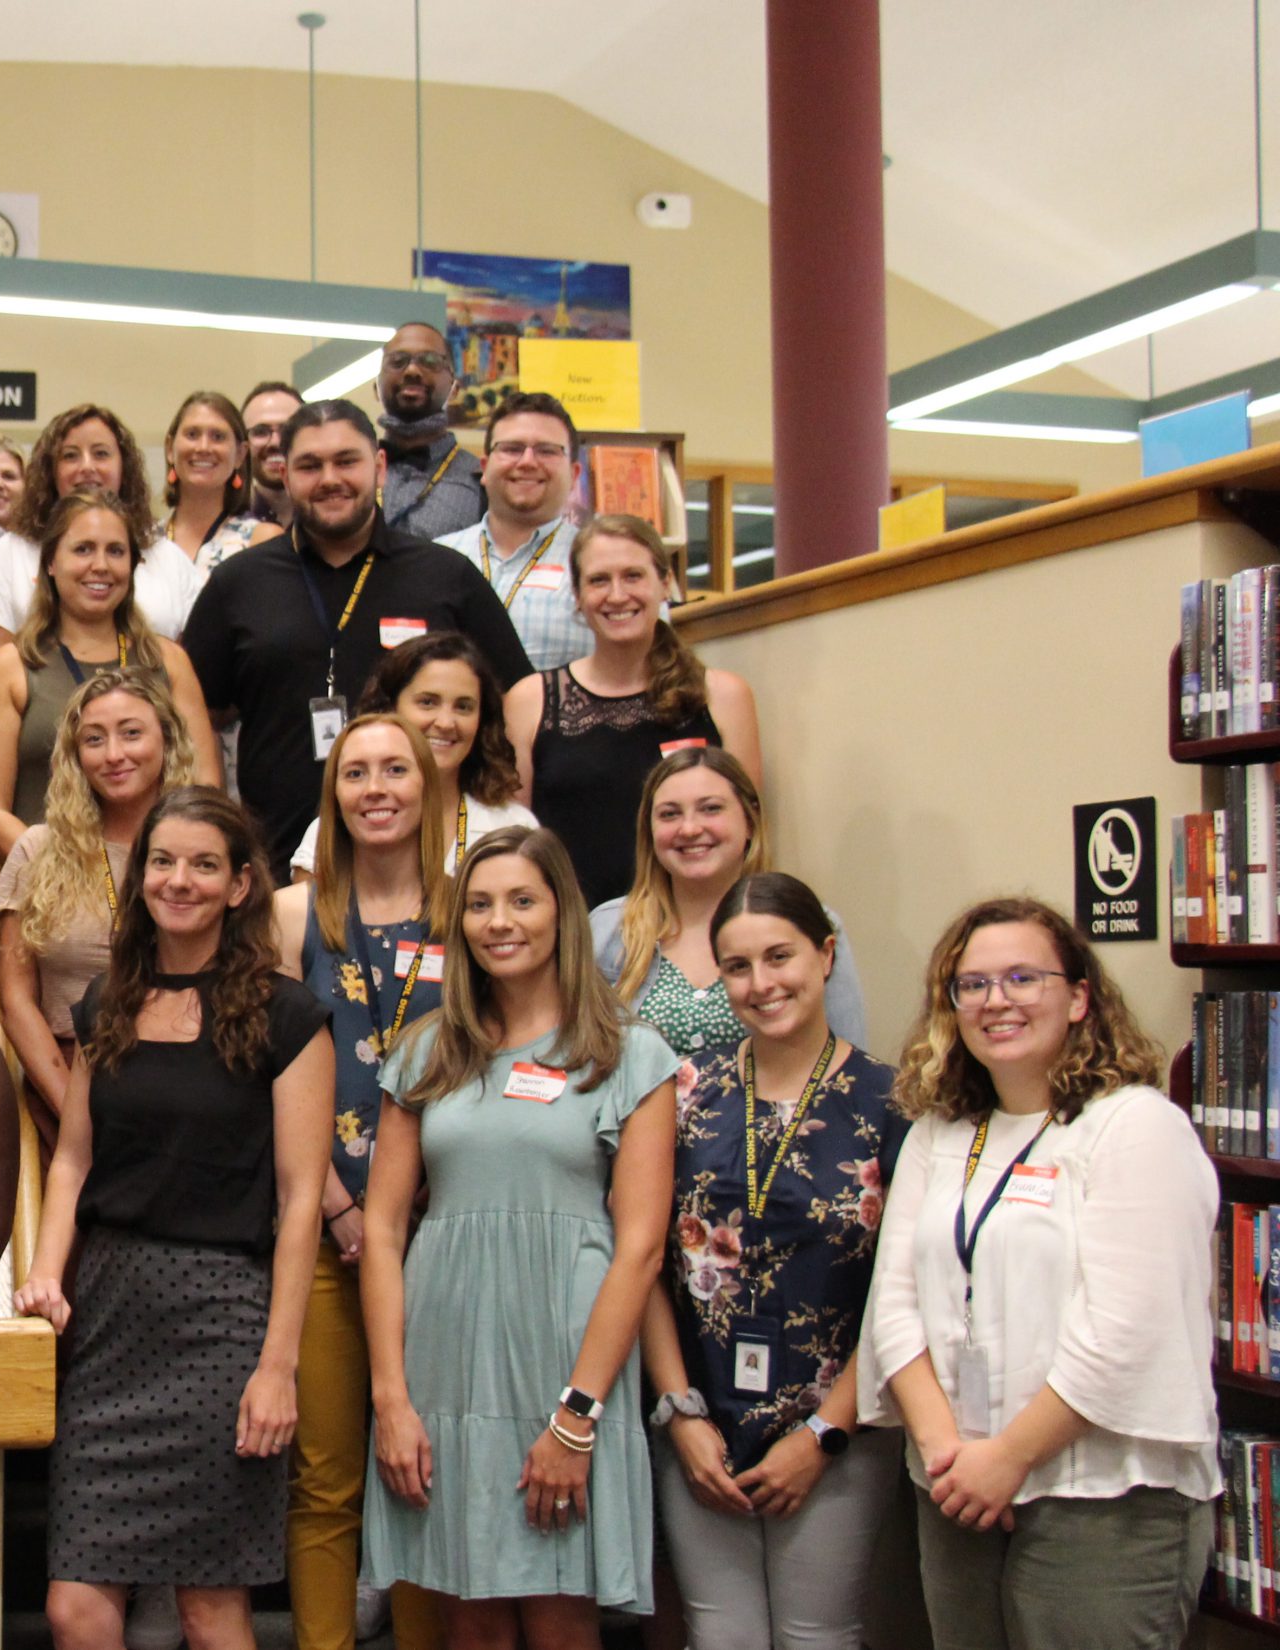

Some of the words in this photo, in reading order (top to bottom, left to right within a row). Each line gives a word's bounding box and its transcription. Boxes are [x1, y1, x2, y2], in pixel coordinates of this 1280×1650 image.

[568, 373, 592, 384] New
[1092, 902, 1107, 916] NO
[1110, 900, 1138, 914] FOOD
[1092, 920, 1107, 933] OR
[1109, 918, 1140, 932] DRINK
[402, 958, 421, 997] SCHOOL
[745, 1083, 756, 1127] CENTRAL
[746, 1128, 757, 1168] SCHOOL
[755, 1193, 767, 1219] PINE
[762, 1164, 778, 1192] BUSH
[774, 1120, 800, 1163] CENTRAL
[794, 1081, 817, 1119] SCHOOL
